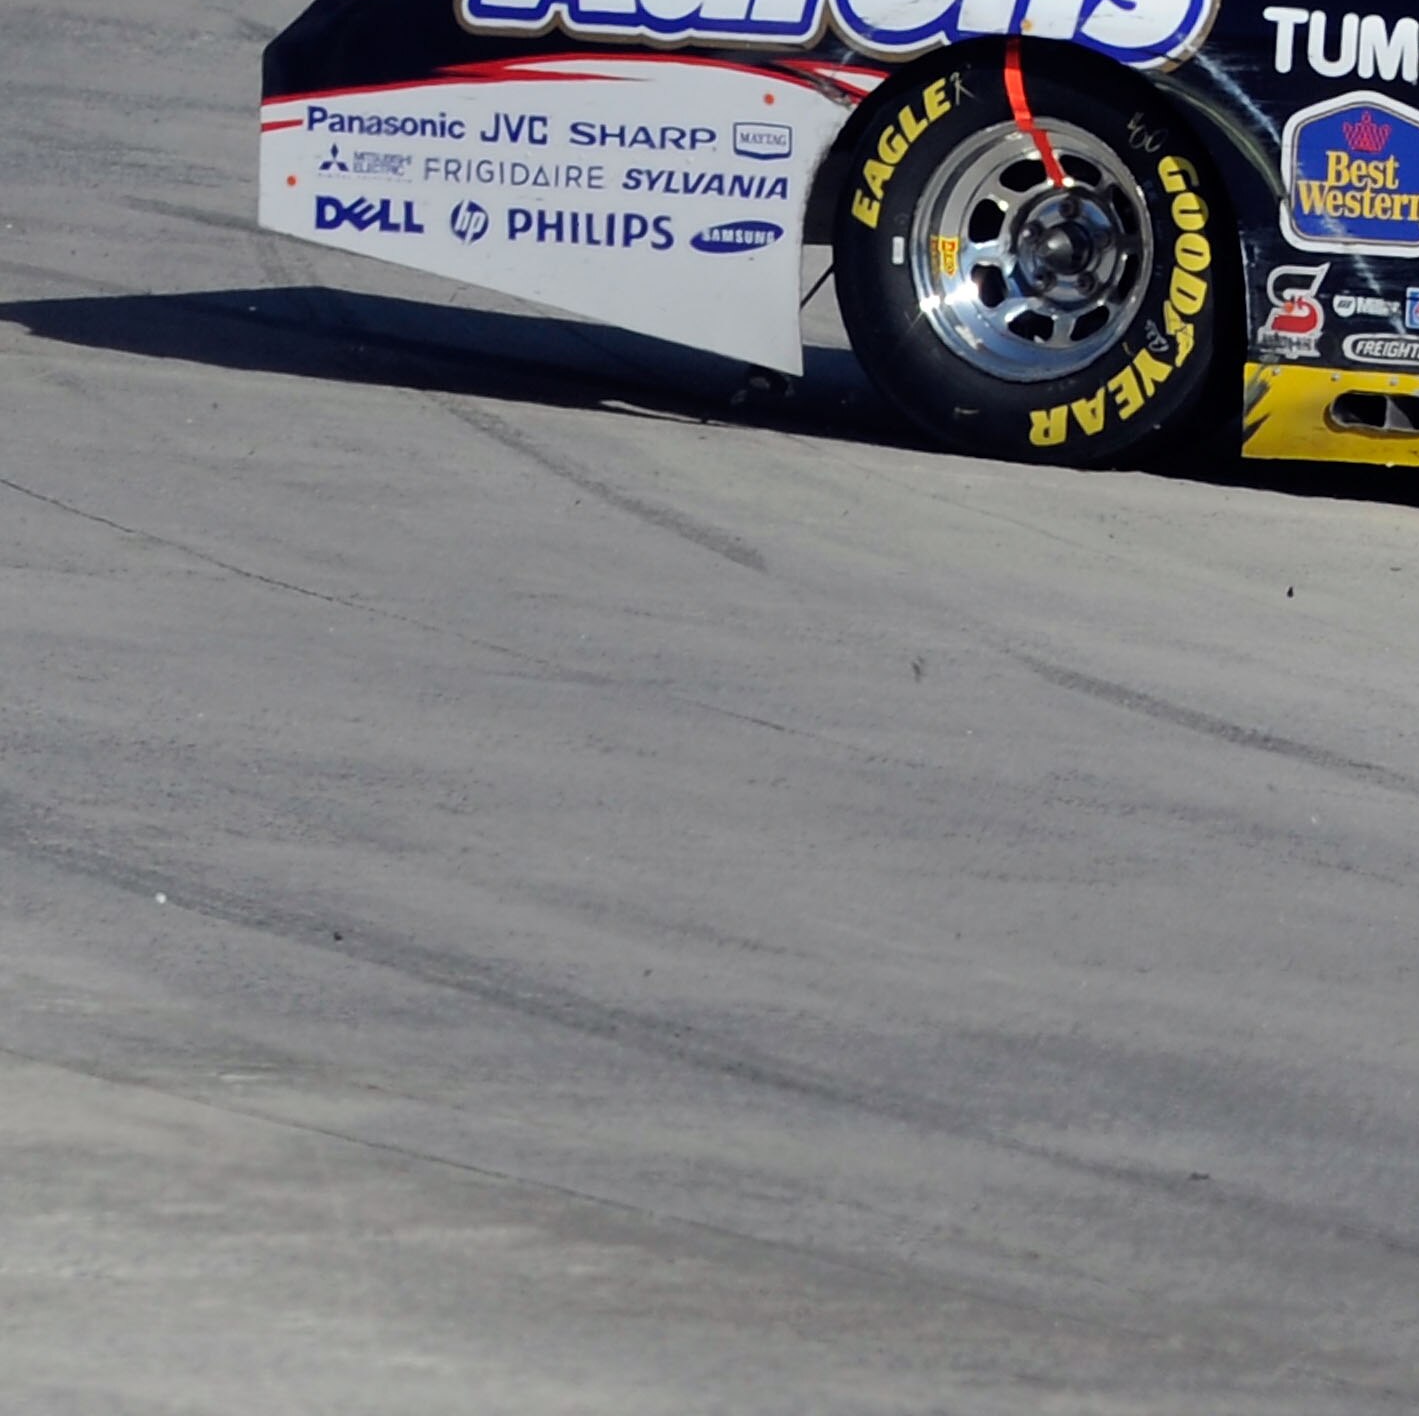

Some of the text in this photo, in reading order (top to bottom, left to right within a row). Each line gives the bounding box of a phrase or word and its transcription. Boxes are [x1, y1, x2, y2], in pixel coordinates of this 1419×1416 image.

[306, 106, 788, 151] Panasonic JVC SHARP MAYTAG
[851, 78, 952, 229] EAGLE
[424, 157, 789, 200] FRIGIDAIRE SYLVANIA
[1326, 151, 1399, 189] Best
[315, 195, 776, 251] DELL hp PHILIPS SAMSUNG
[1029, 155, 1212, 446] GOODYEAR
